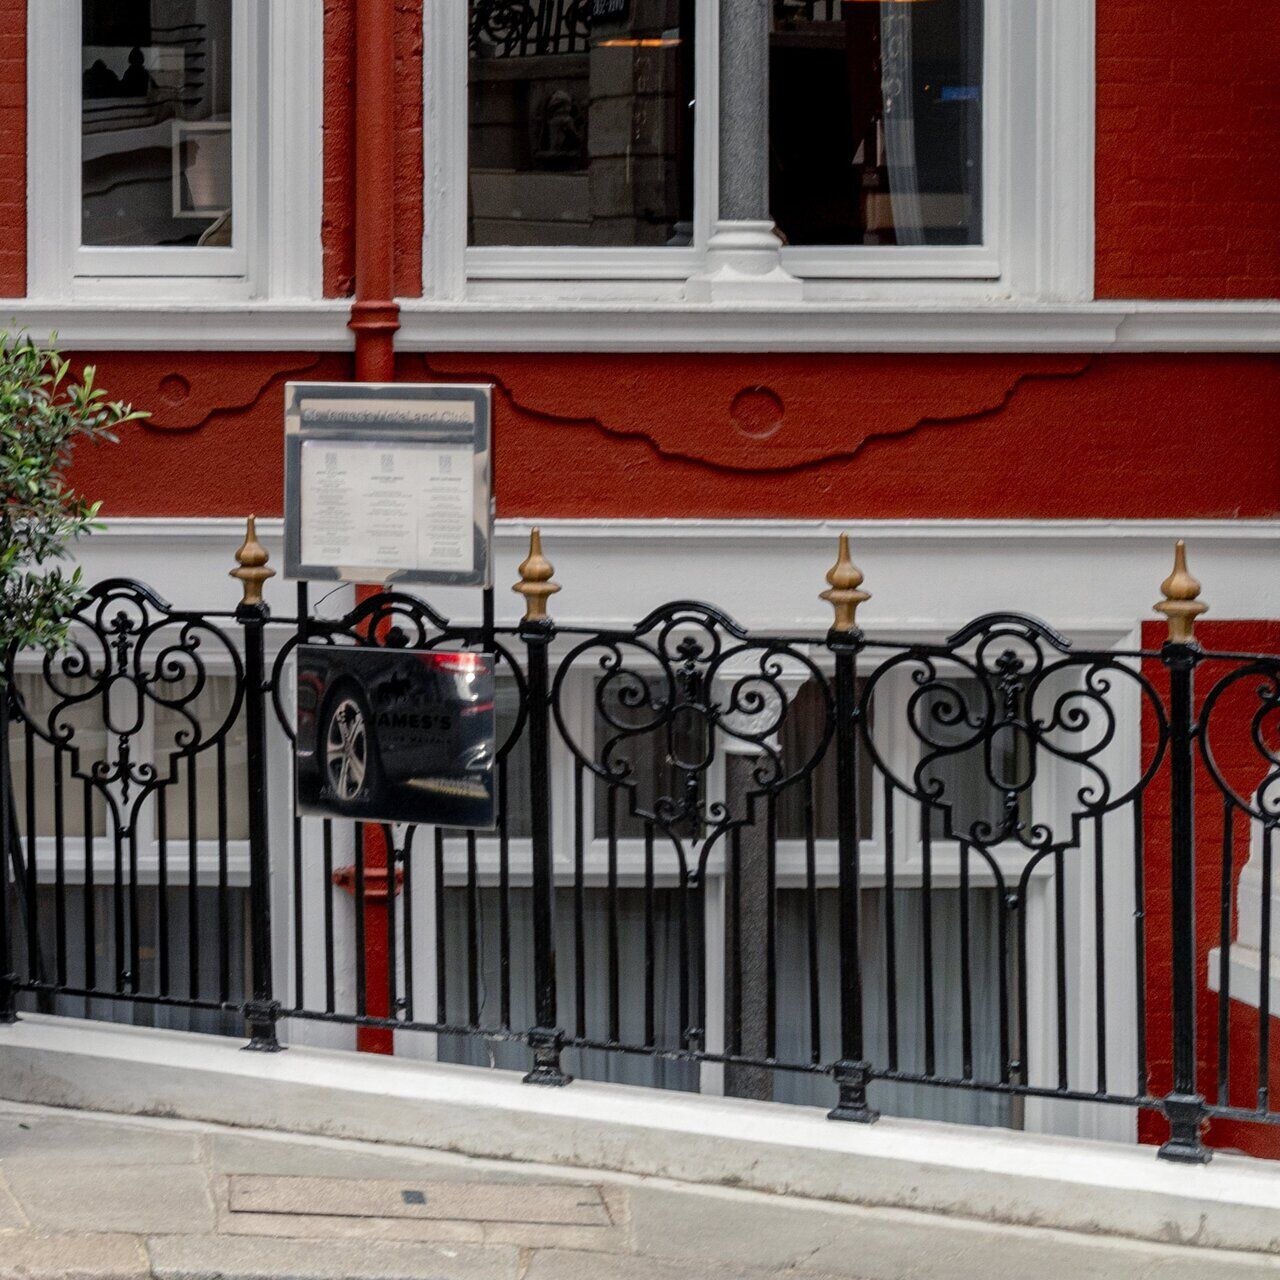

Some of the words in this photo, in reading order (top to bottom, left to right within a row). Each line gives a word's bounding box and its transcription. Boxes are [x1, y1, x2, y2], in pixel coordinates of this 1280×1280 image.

[376, 410, 411, 425] Hotel
[414, 411, 438, 426] and
[441, 411, 470, 427] Club
